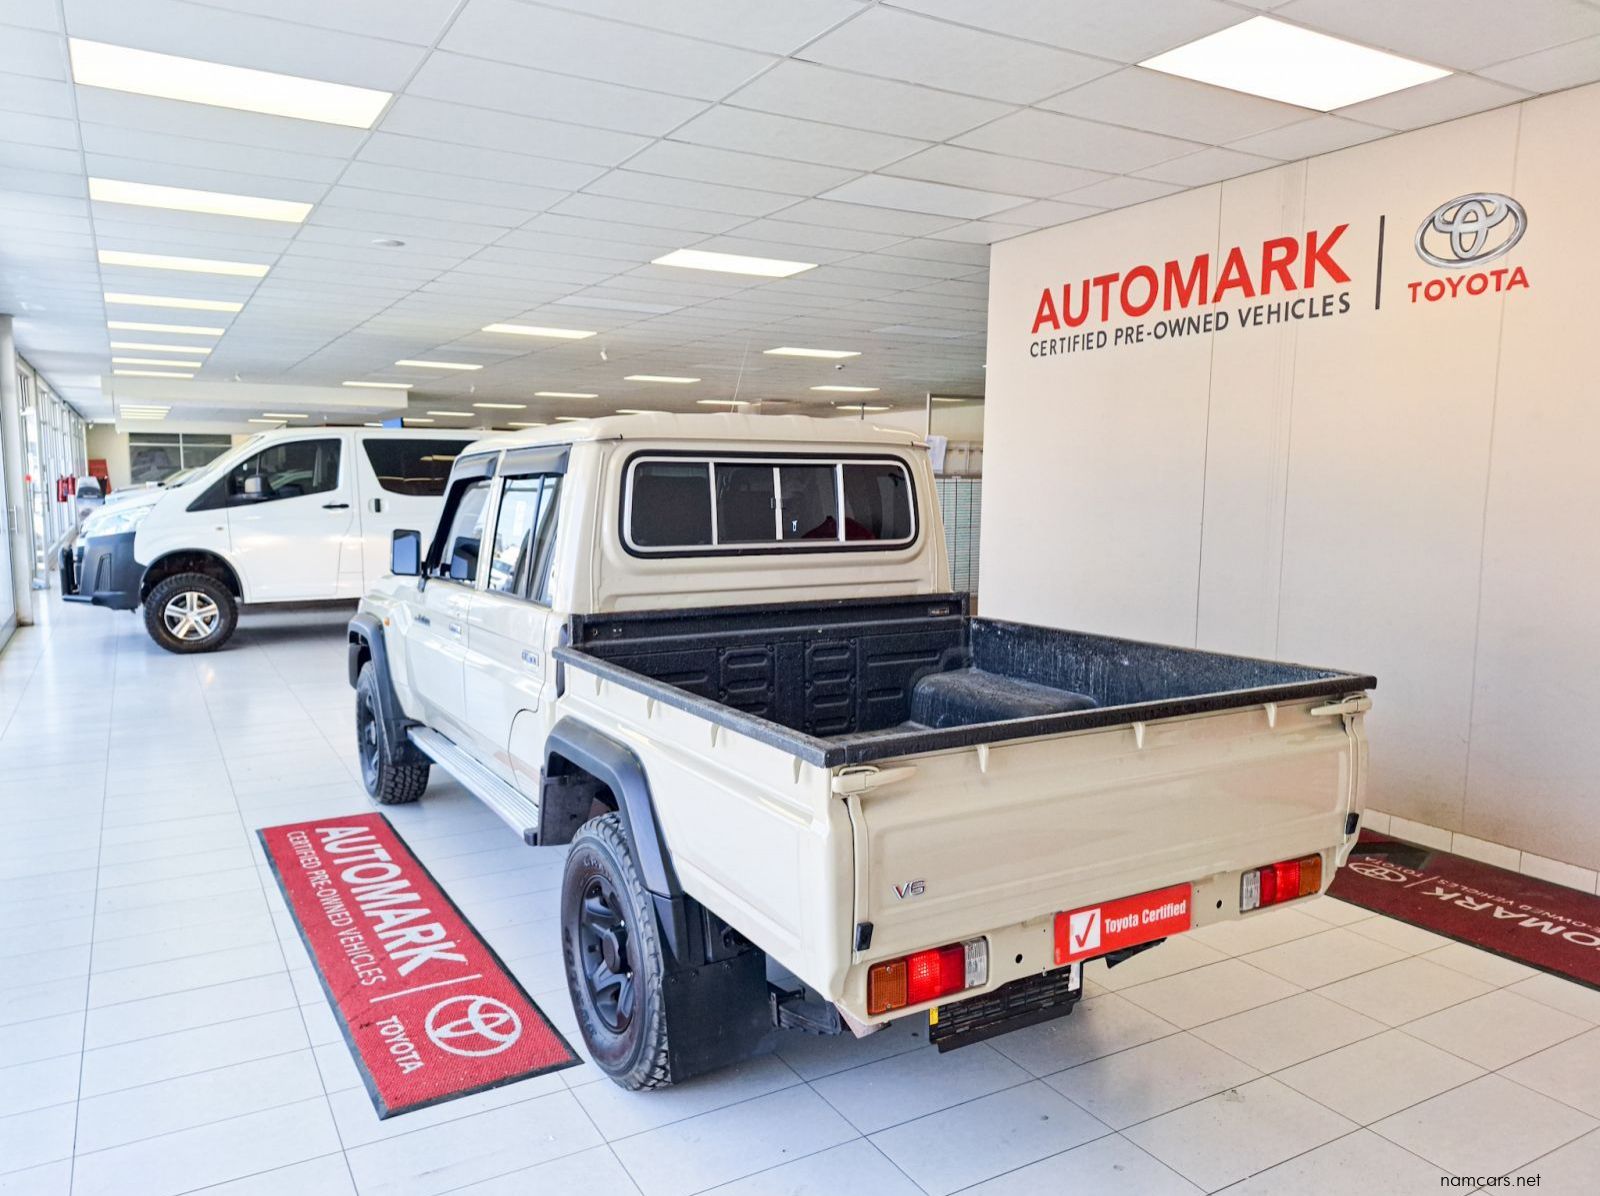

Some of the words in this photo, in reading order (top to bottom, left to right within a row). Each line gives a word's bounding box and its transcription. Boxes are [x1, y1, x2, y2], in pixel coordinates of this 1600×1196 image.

[1031, 223, 1352, 334] AUTOMARK
[1407, 266, 1530, 303] TOYOTA
[1030, 330, 1107, 358] CERTIFIED
[1114, 311, 1229, 346] PRE-OWNED
[1238, 292, 1350, 328] VEHICLES
[287, 830, 321, 869] CERTIFIED
[306, 869, 353, 927] PRE-OWNED
[337, 926, 387, 986] VEHICLES
[315, 826, 468, 977] AUTOMARK
[892, 879, 925, 900] V6
[1105, 914, 1139, 934] Toyota
[1142, 900, 1187, 924] Certified
[1421, 886, 1600, 951] OMARK
[376, 1015, 425, 1074] TOYOTA
